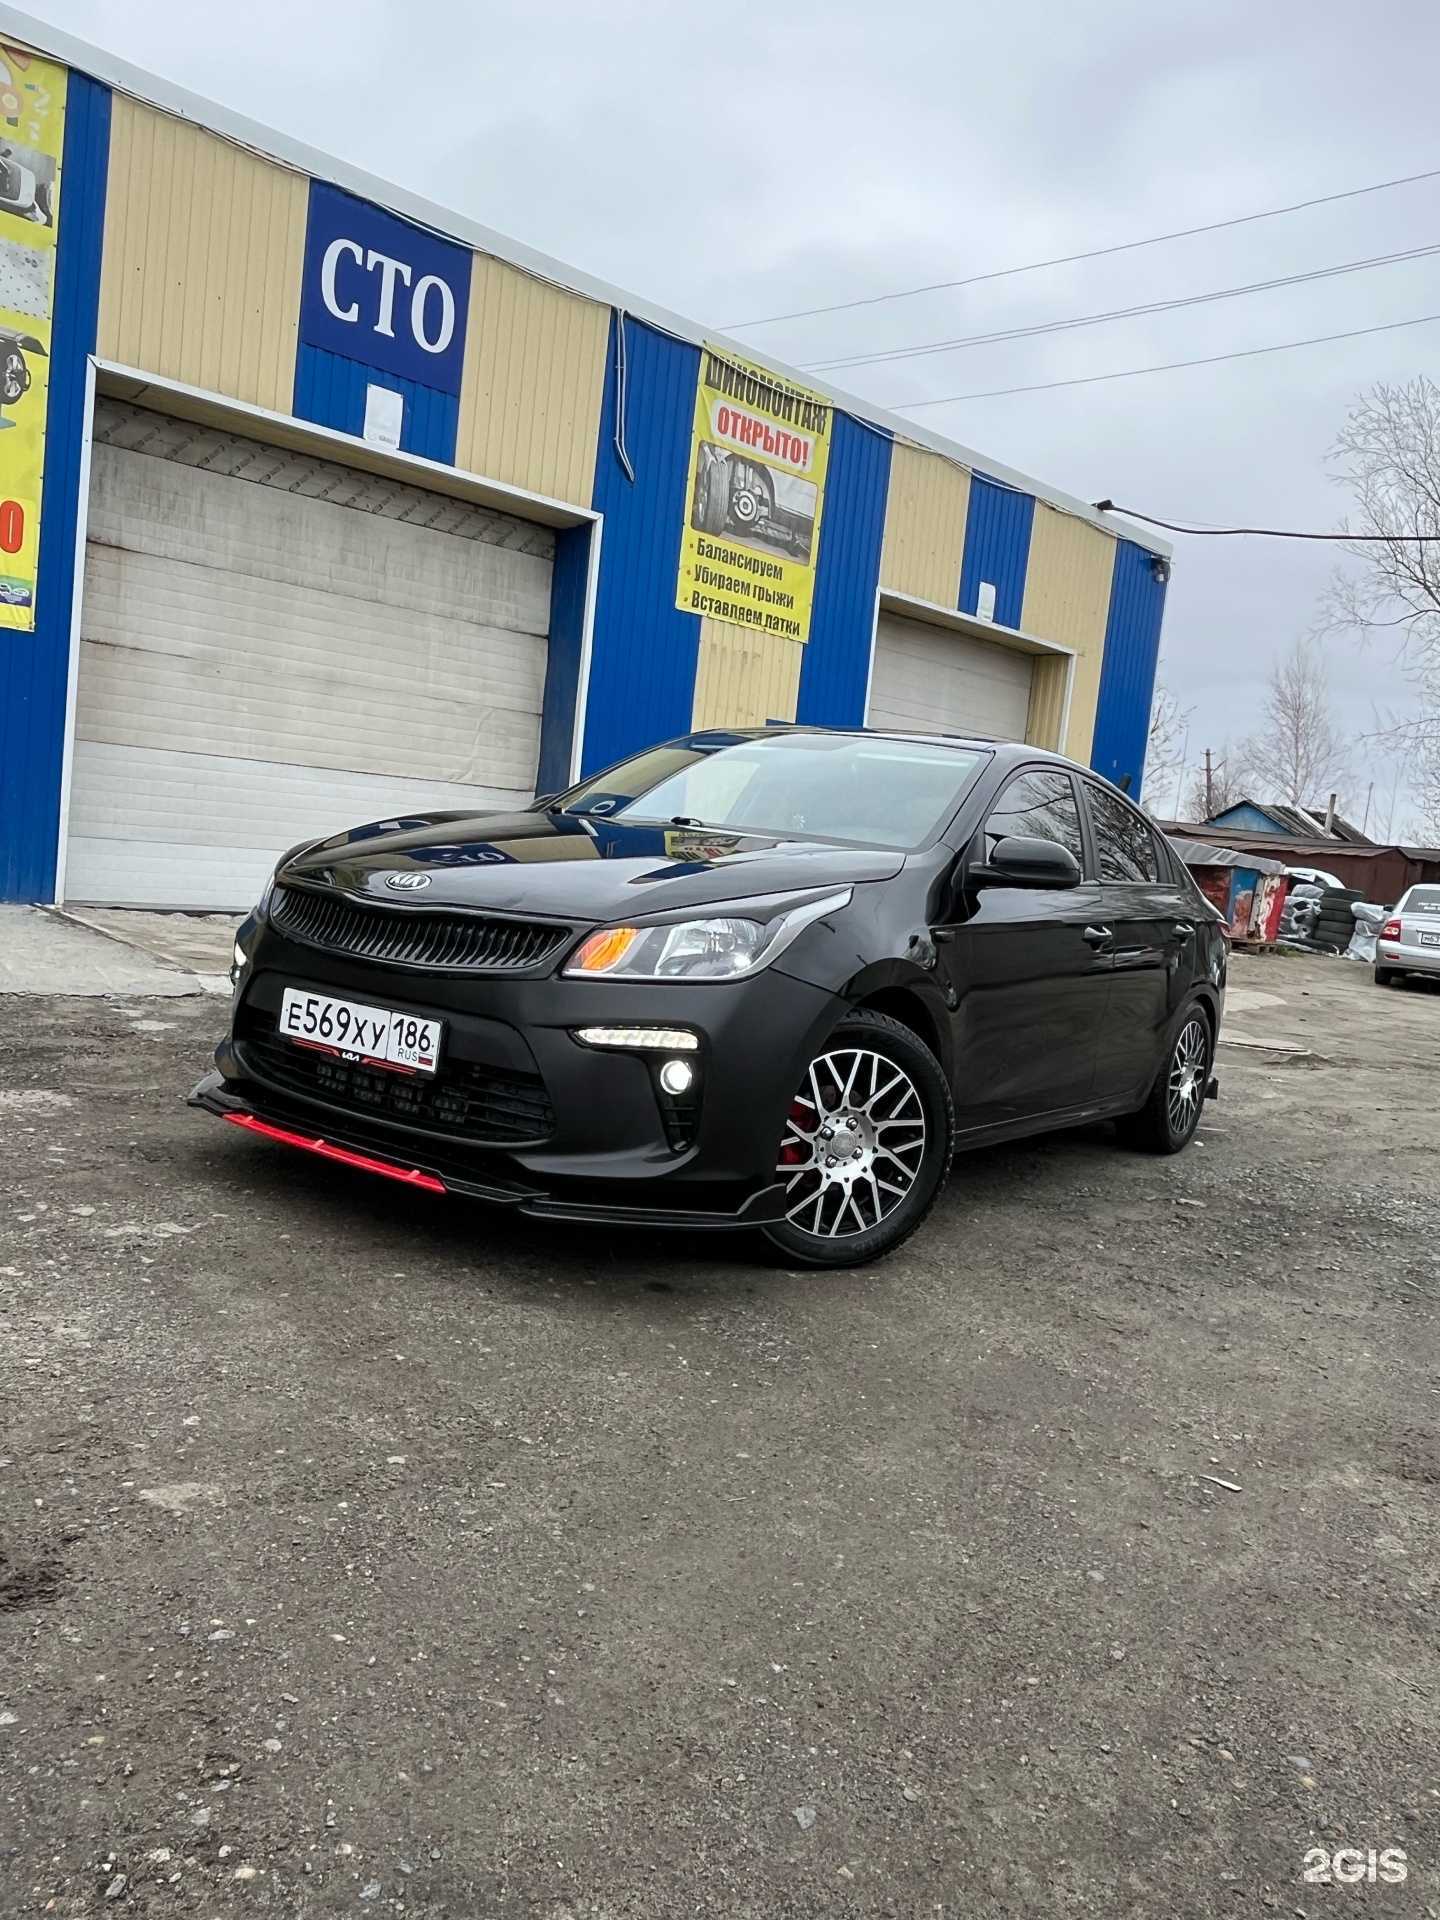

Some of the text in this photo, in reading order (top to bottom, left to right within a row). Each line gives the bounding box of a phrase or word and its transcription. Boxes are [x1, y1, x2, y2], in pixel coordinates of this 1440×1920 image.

[321, 238, 455, 354] СТО
[704, 355, 828, 436] ШИНОМОНТАЖ
[717, 406, 809, 467] ОТКРЫТО!
[696, 537, 784, 581] Балансируем
[693, 564, 795, 610] Убираем грыжи
[691, 590, 801, 636] Вставляем латки
[393, 1018, 431, 1052] 186
[397, 1048, 418, 1062] RUS
